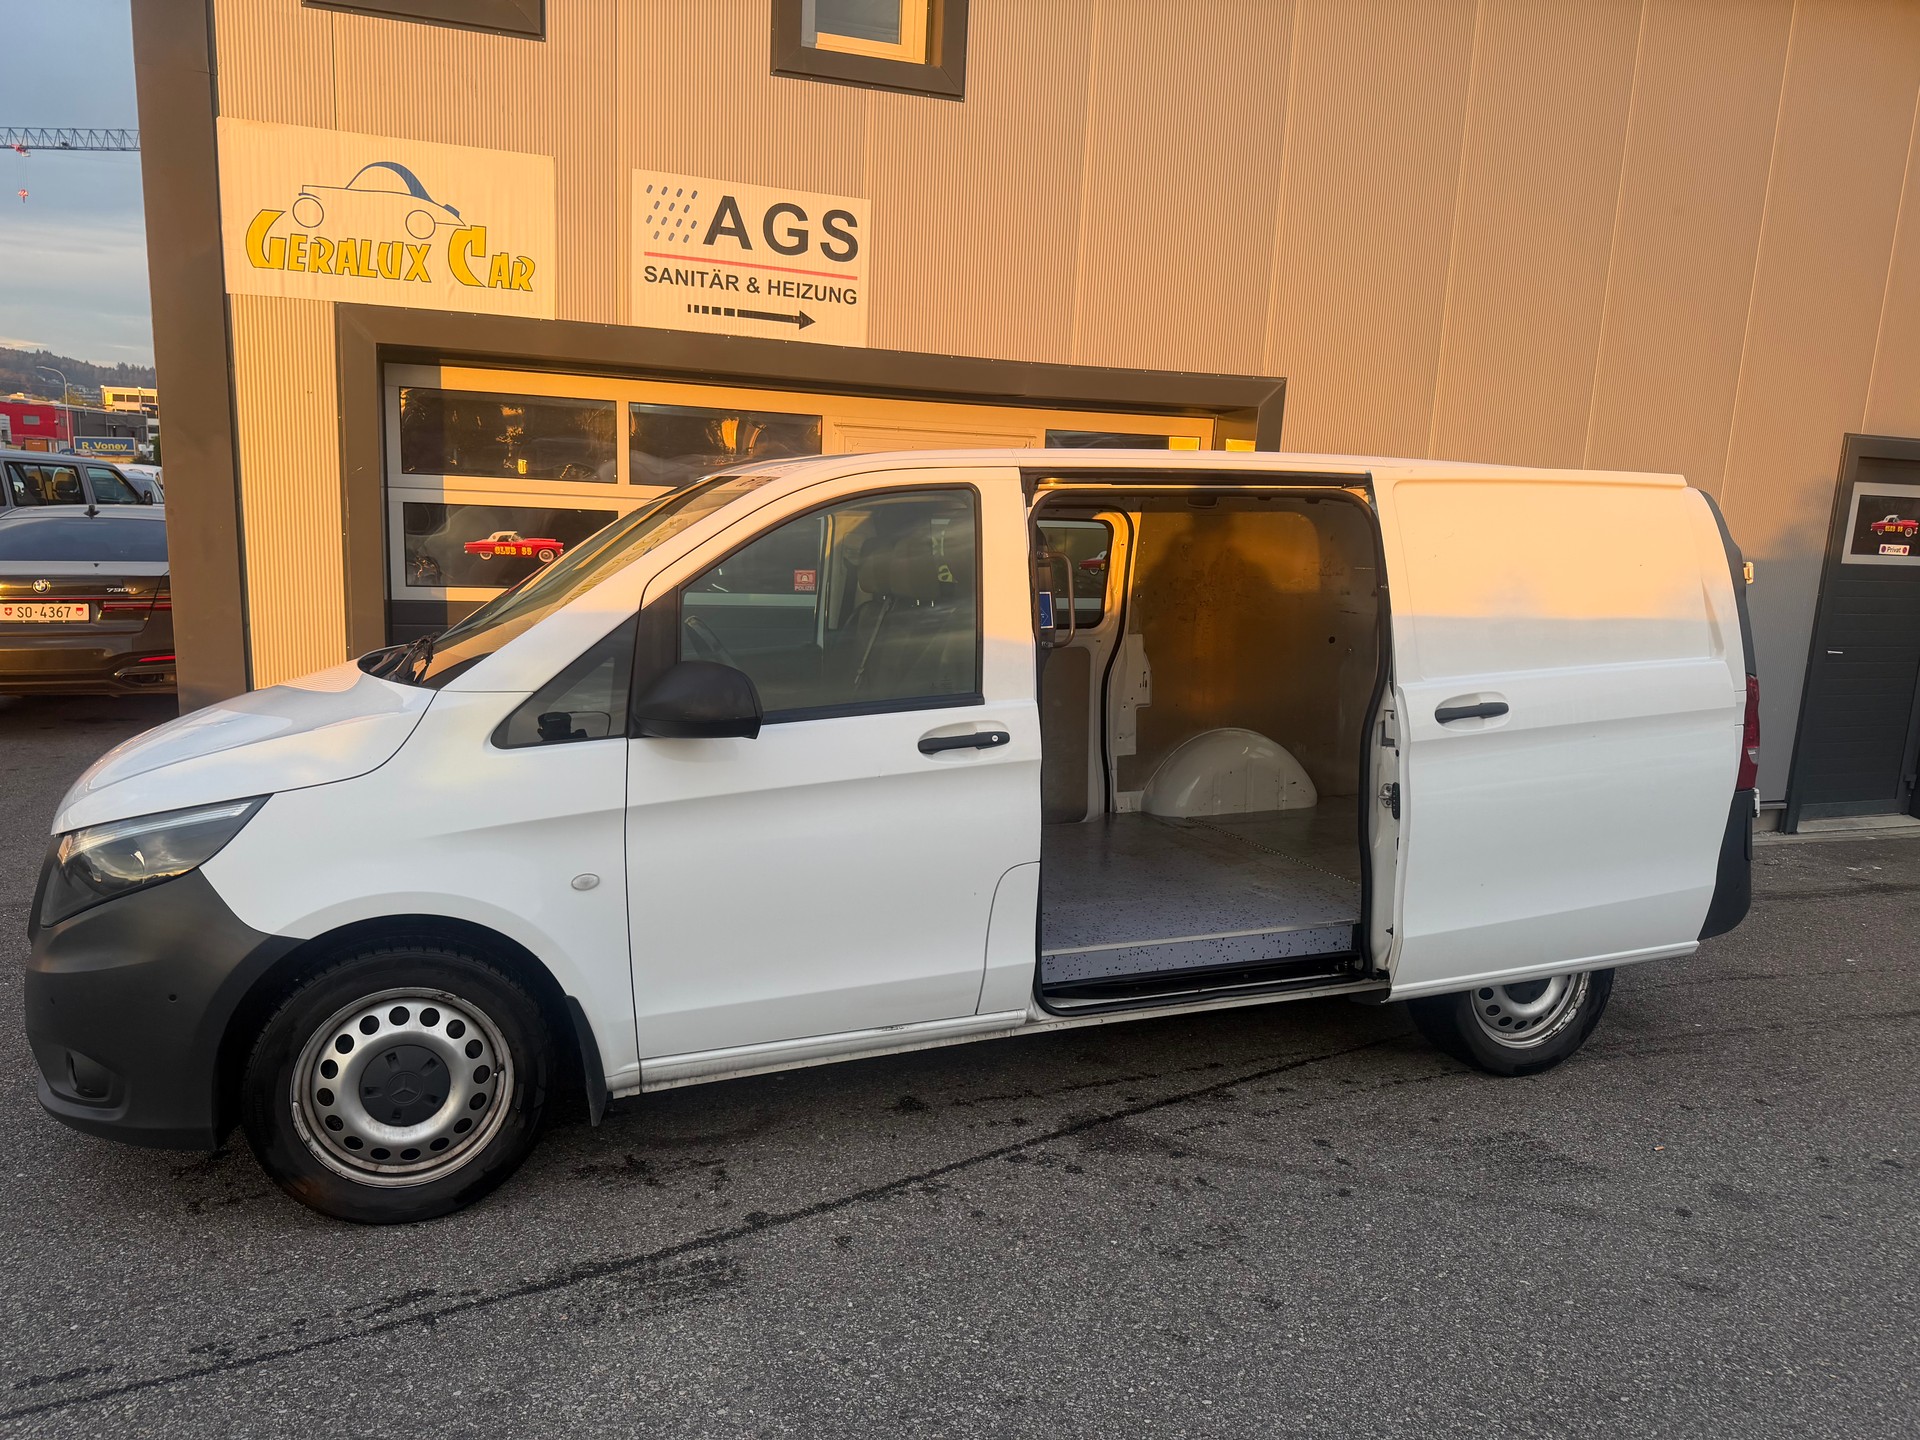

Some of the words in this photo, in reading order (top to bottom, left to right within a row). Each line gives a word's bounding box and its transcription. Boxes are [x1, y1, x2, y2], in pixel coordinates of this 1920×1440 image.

[702, 195, 859, 262] AGS
[643, 265, 740, 291] SANITÄR
[746, 277, 760, 294] &
[767, 279, 858, 305] HEIZUNG
